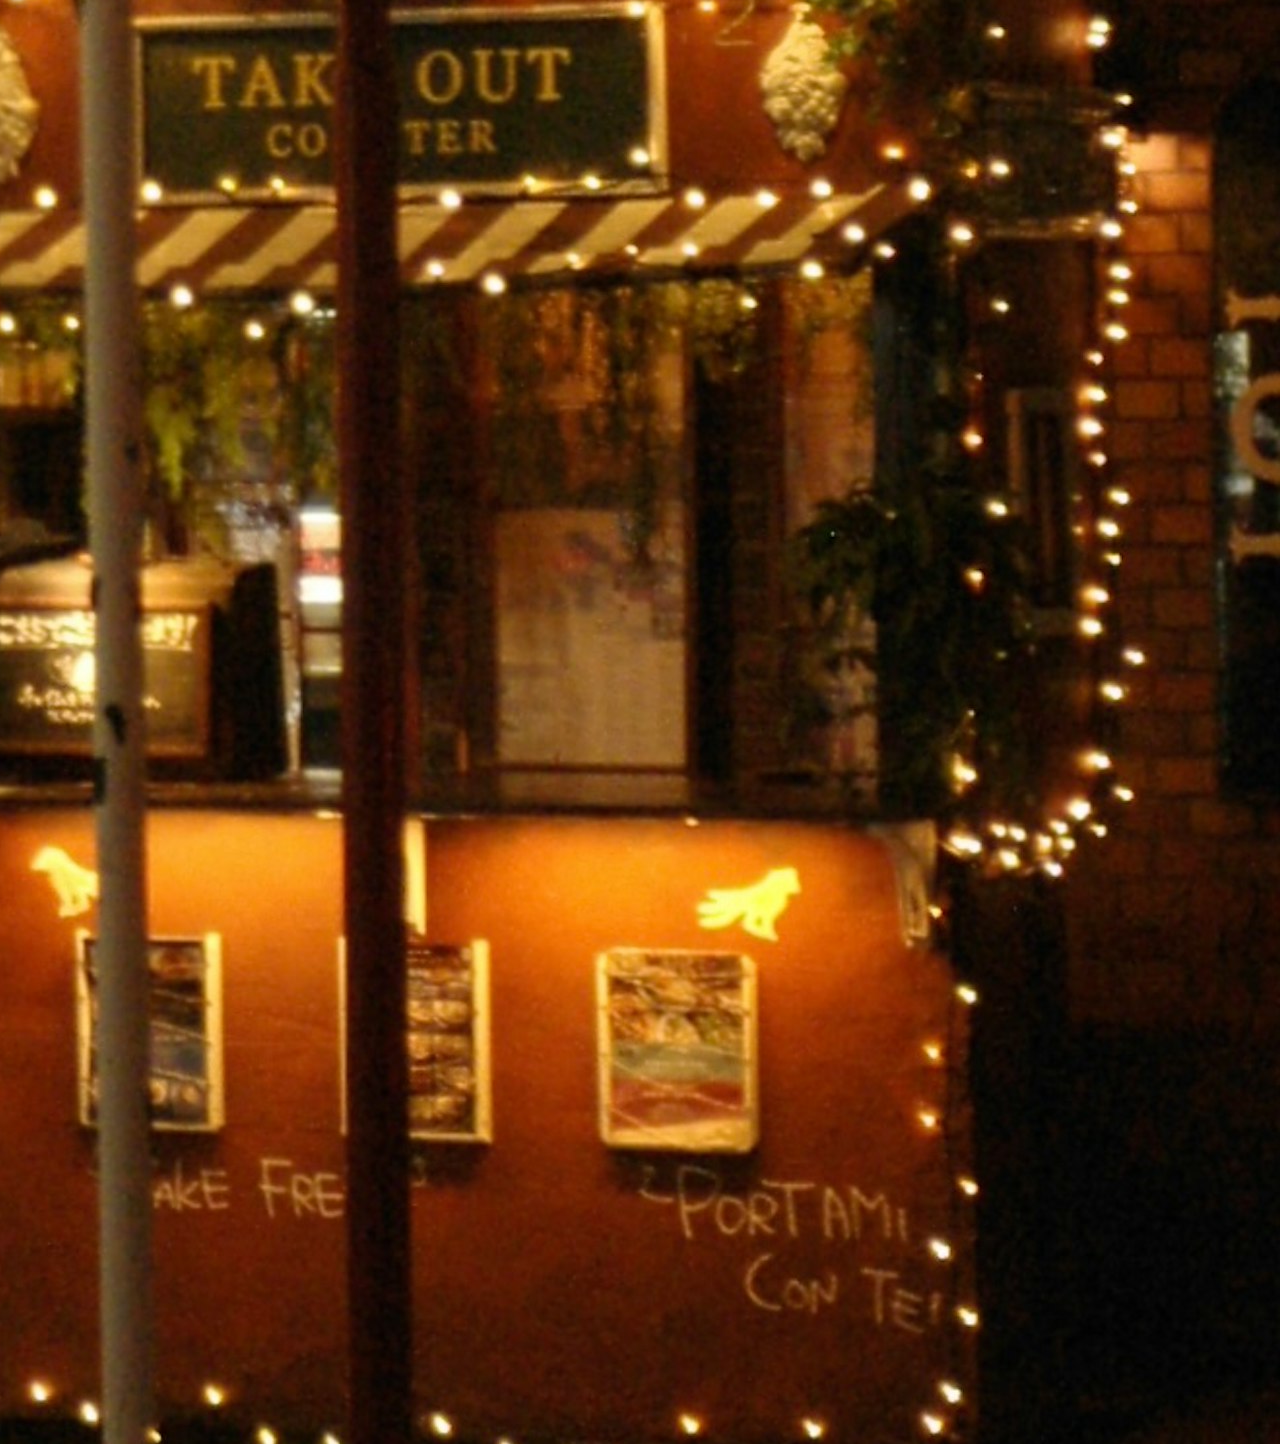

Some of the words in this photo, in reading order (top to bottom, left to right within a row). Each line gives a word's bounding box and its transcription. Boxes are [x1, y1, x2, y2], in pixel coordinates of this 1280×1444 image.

[191, 49, 336, 108] TAK
[416, 46, 572, 104] OUT
[266, 119, 498, 159] COTER
[130, 1160, 230, 1211] AKE
